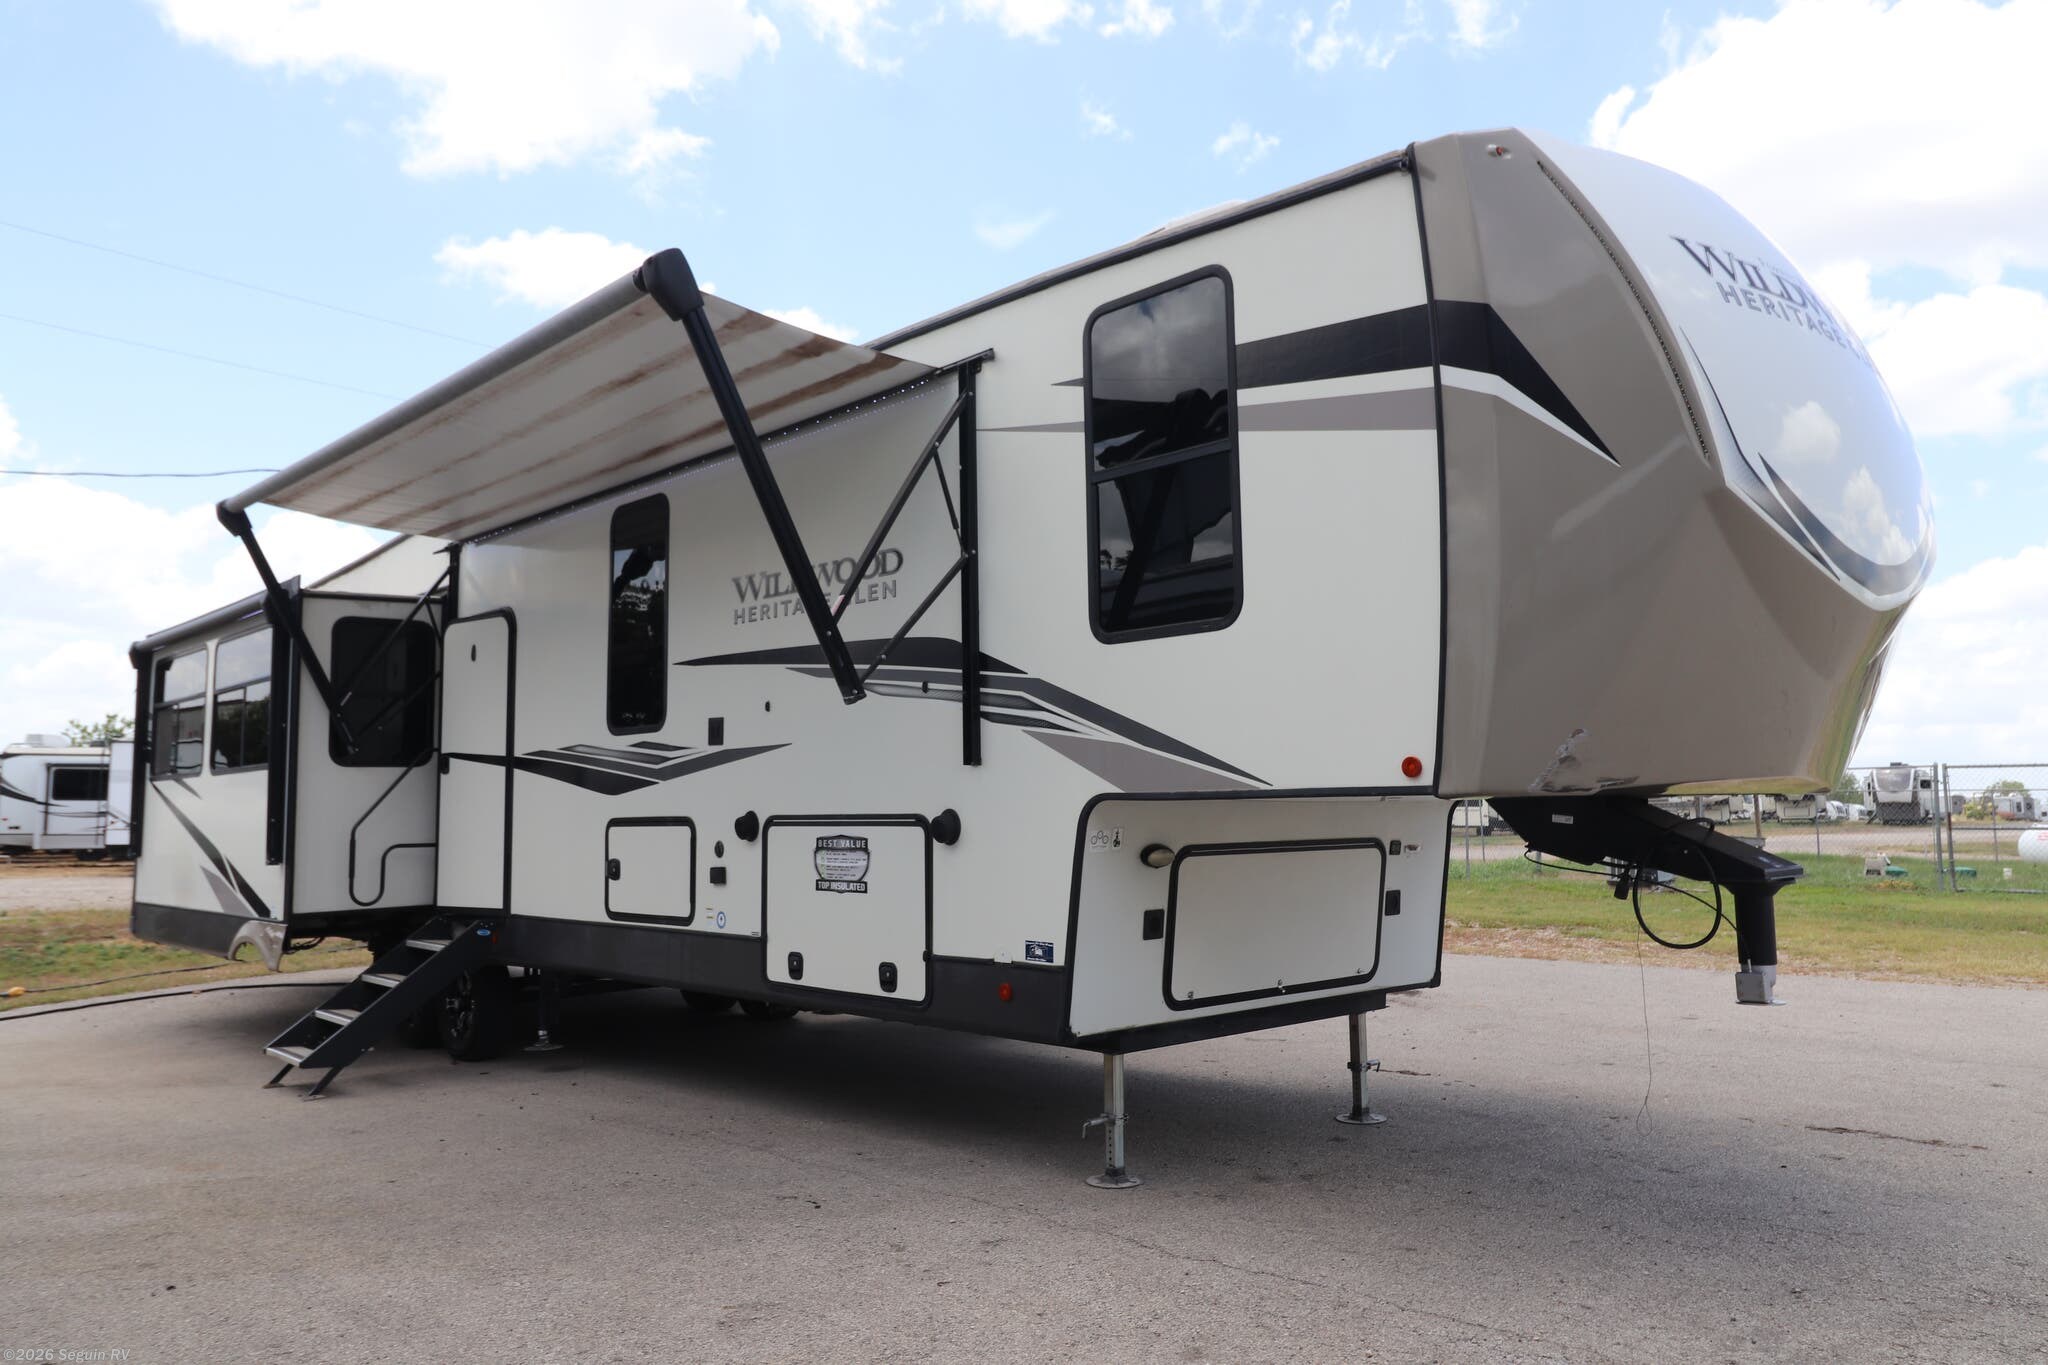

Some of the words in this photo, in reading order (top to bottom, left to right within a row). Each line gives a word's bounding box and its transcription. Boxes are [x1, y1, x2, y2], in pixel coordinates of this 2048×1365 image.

[731, 547, 904, 604] WILWOOD
[848, 579, 897, 606] LEN
[817, 839, 838, 848] BEST
[840, 839, 866, 848] VALUE
[817, 881, 830, 889] TOP
[830, 881, 866, 891] INSULATED
